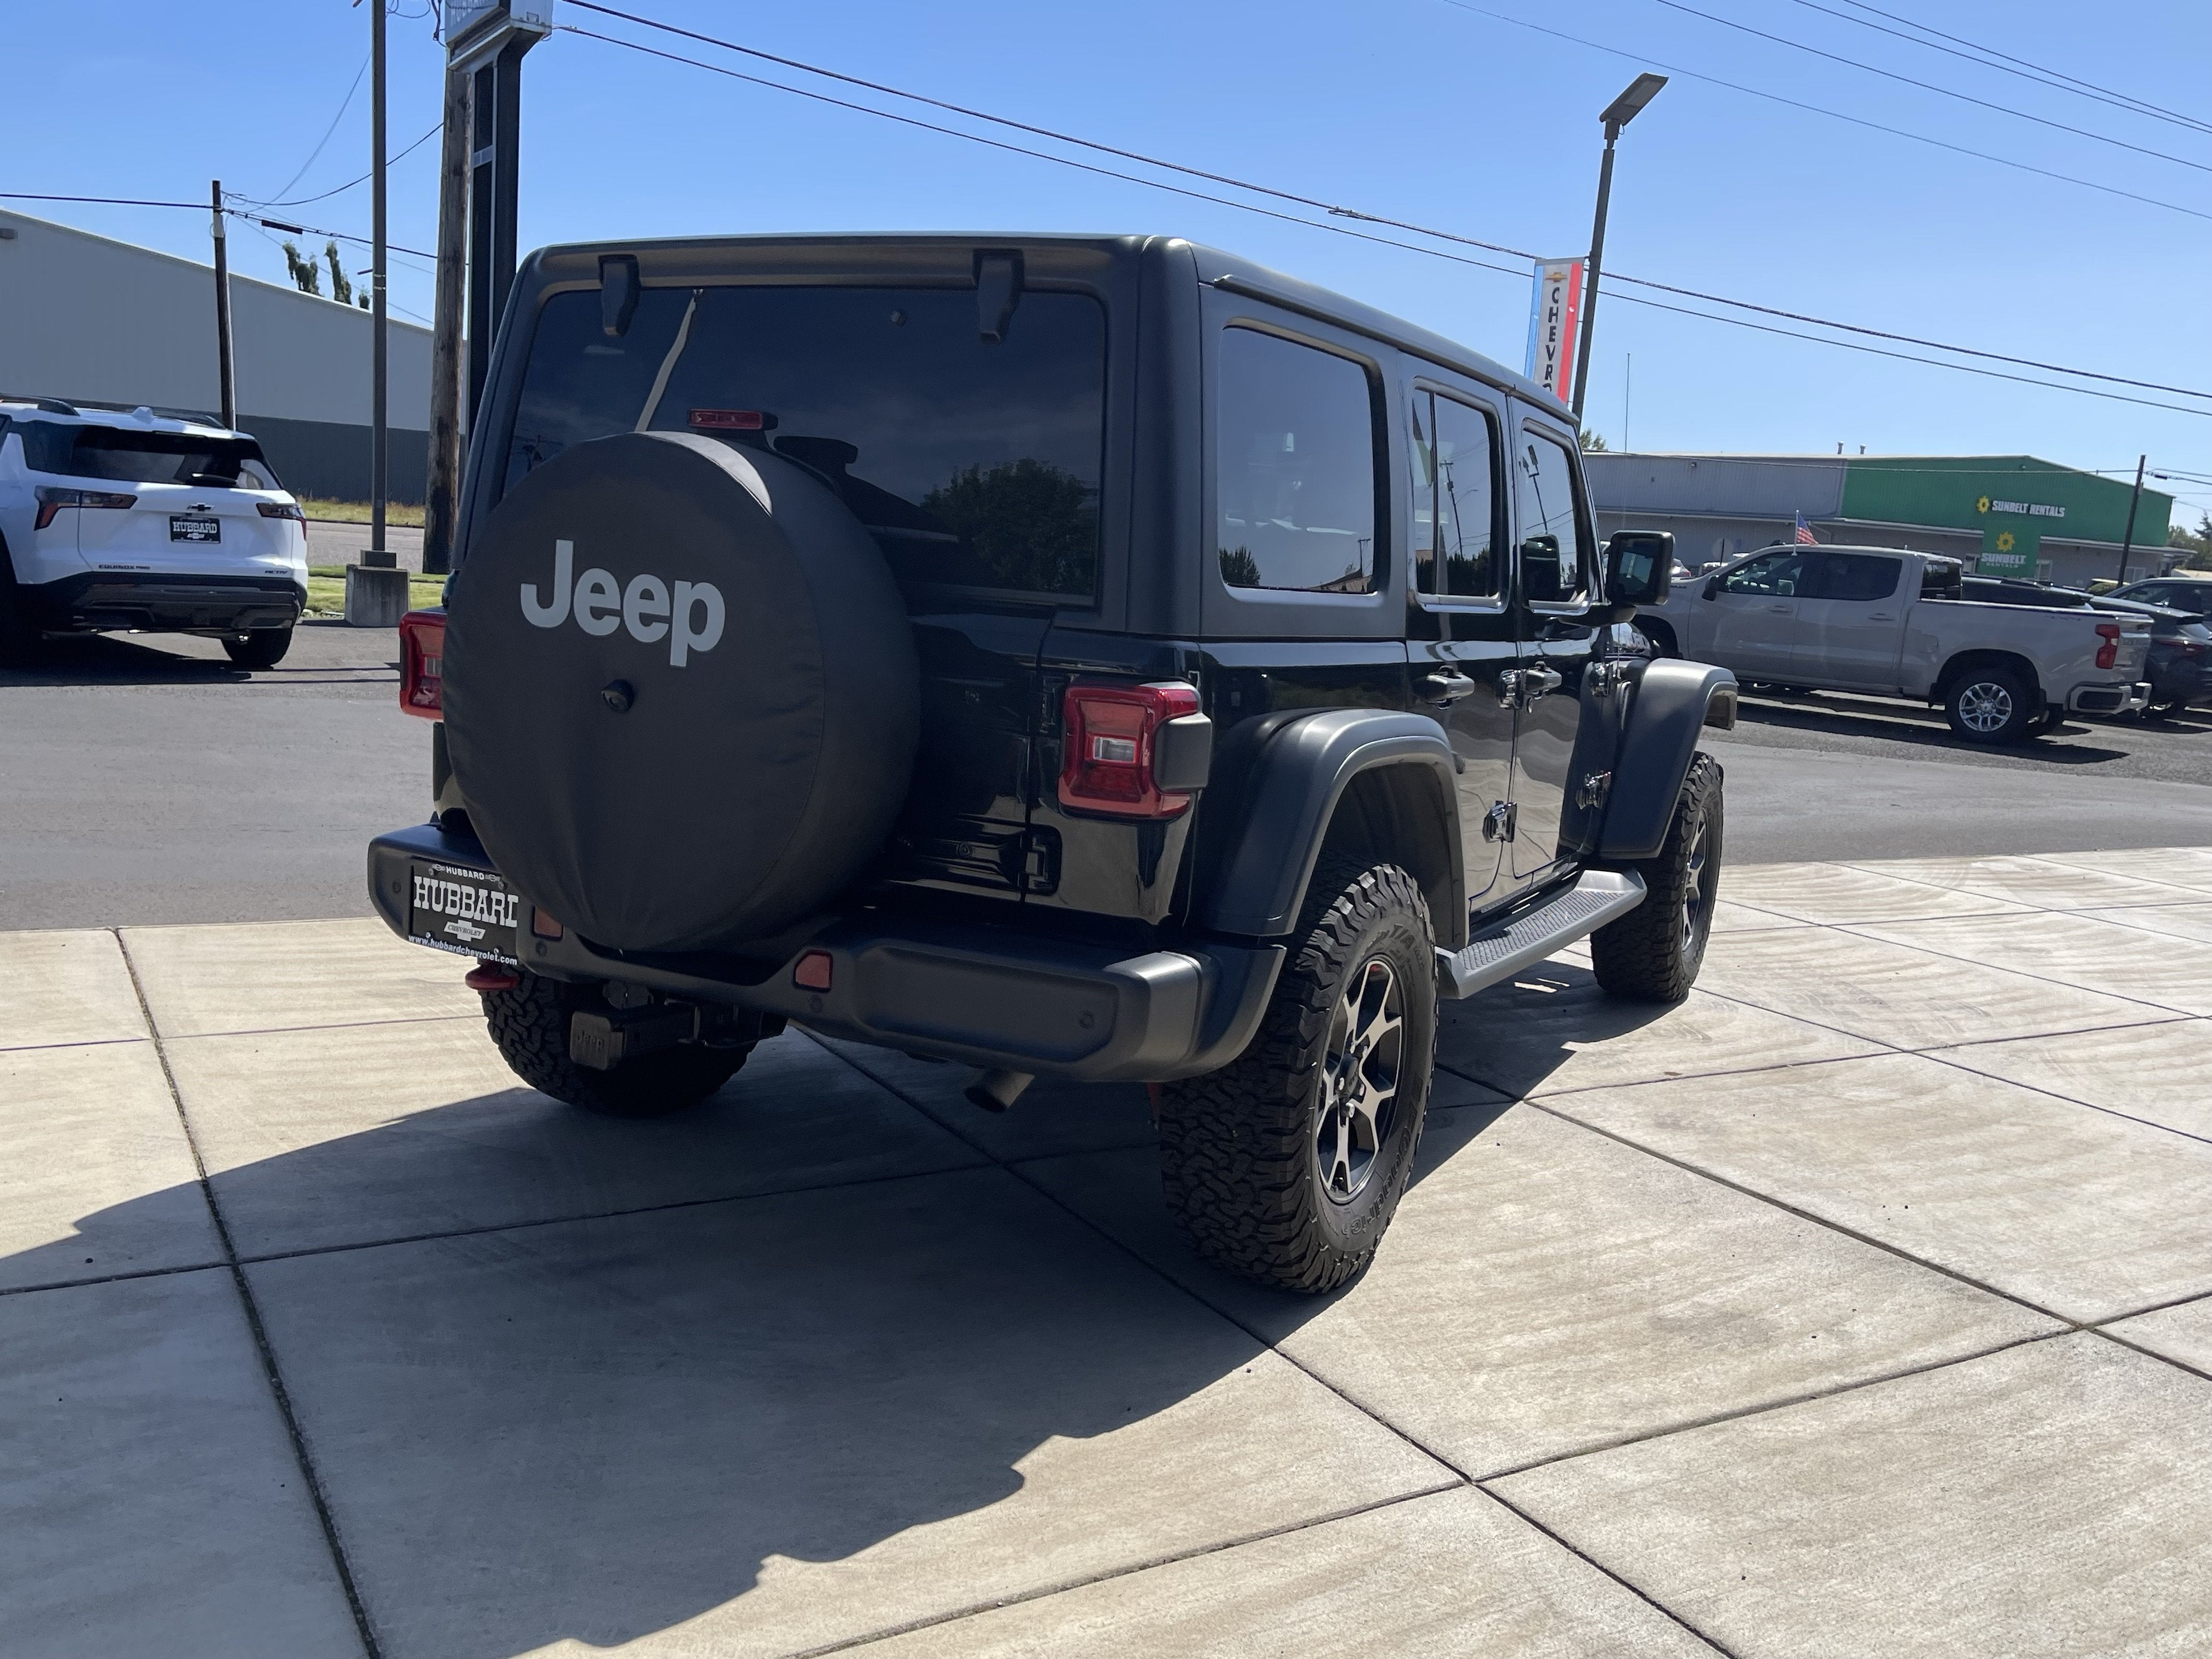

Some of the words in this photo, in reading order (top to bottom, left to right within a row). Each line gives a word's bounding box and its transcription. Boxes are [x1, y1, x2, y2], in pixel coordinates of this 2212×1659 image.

[1991, 500, 2029, 514] SUNBELT
[2029, 504, 2066, 518] RENTALS
[172, 521, 218, 533] HUBBARD
[1980, 552, 2027, 565] SUNBELT
[520, 539, 726, 668] Jeep
[445, 865, 485, 881] HUBBARD
[447, 923, 483, 938] CHEVROLET
[408, 934, 517, 966] www.hubbardchevrolet.com
